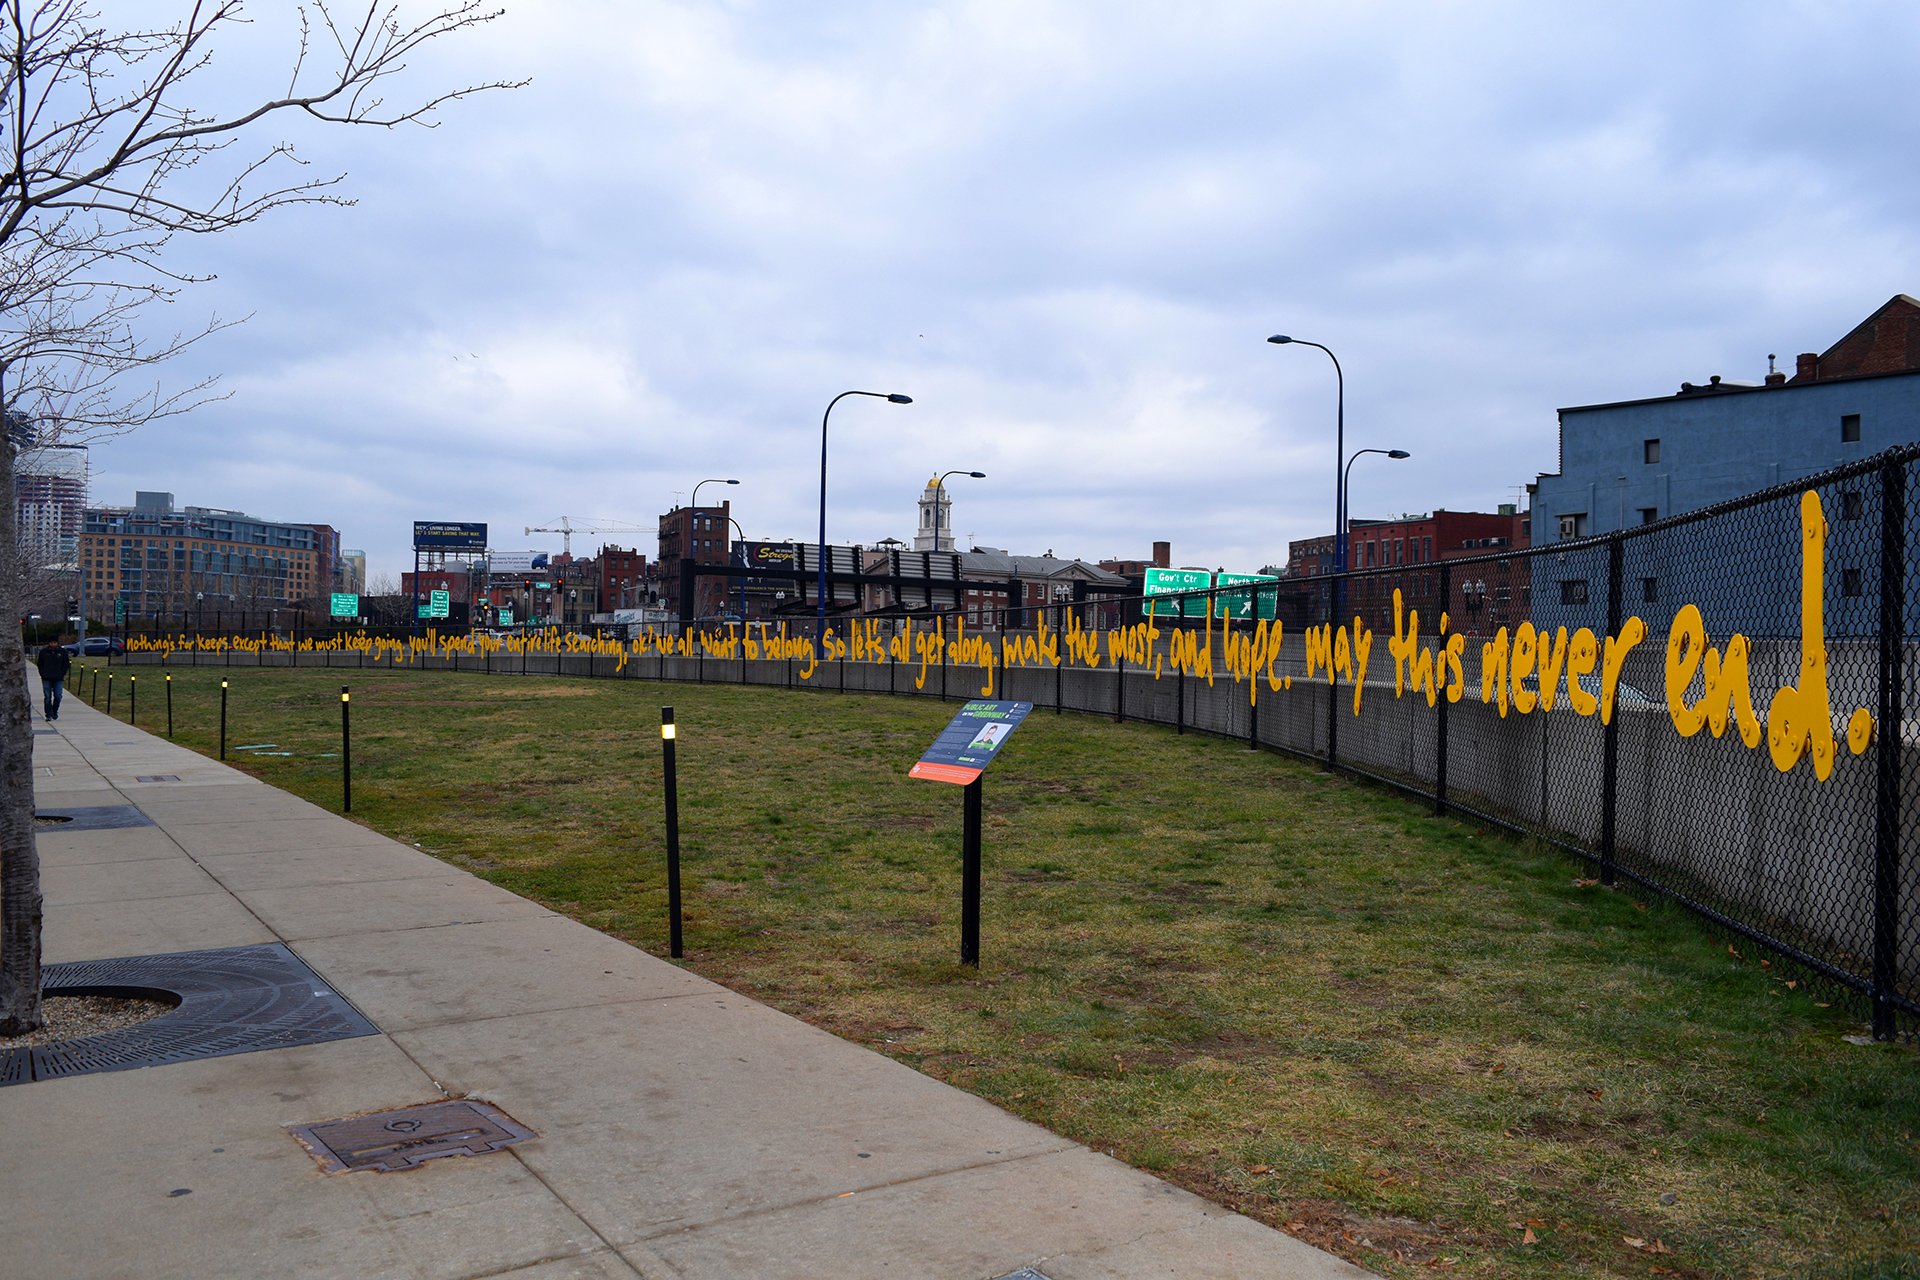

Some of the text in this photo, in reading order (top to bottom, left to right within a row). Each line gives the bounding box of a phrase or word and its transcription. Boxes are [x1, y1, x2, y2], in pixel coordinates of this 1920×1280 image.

[126, 633, 176, 659] nothing's
[178, 633, 194, 651] for
[233, 630, 268, 657] except
[269, 630, 296, 652] that
[298, 637, 313, 652] we
[315, 632, 343, 652] must
[344, 631, 373, 656] keep
[408, 627, 437, 664] you'll
[477, 632, 503, 660] your
[506, 627, 542, 656] entire
[543, 625, 562, 654] life
[655, 634, 675, 656] we
[677, 626, 694, 657] all
[700, 623, 739, 660] want
[742, 622, 759, 661] to
[761, 619, 819, 680] belong.
[851, 617, 886, 665] let's
[890, 615, 911, 665] all
[915, 615, 946, 689] get
[947, 615, 999, 697] along.
[1002, 609, 1061, 670] make
[1065, 606, 1100, 669] the
[1108, 598, 1163, 681] most,
[1170, 595, 1214, 688] and
[1223, 606, 1292, 707] hope.
[1305, 615, 1374, 717] may
[1388, 587, 1467, 708] this
[1482, 615, 1650, 727] never
[1665, 489, 1877, 783] end.
[1158, 573, 1198, 583] Gov't Ctr
